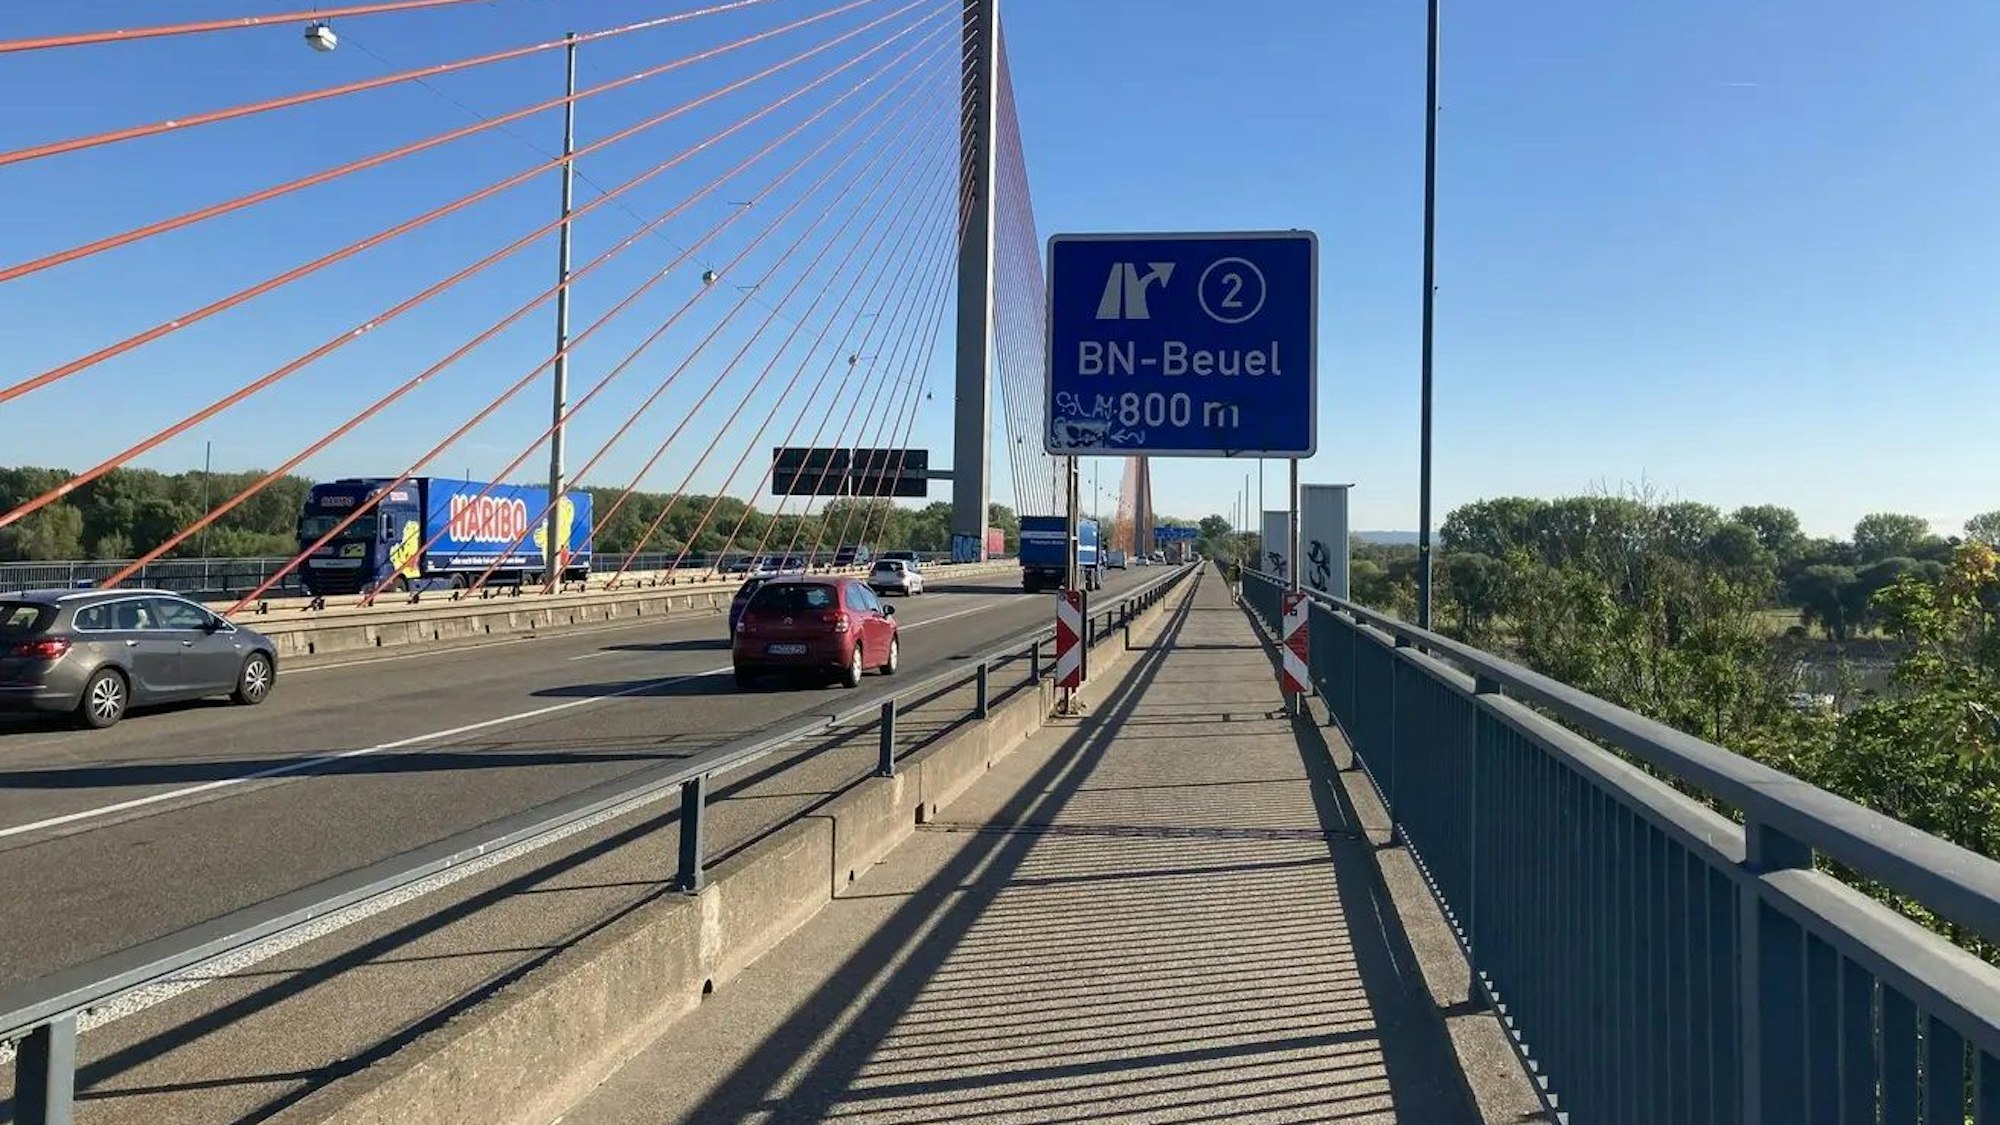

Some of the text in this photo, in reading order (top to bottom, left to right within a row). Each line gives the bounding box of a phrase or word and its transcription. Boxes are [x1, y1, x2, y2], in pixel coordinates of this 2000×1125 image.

[1220, 272, 1244, 308] 2
[1078, 340, 1282, 377] BN-Beuel
[1118, 392, 1240, 428] 800 m
[450, 494, 527, 542] HARIBO
